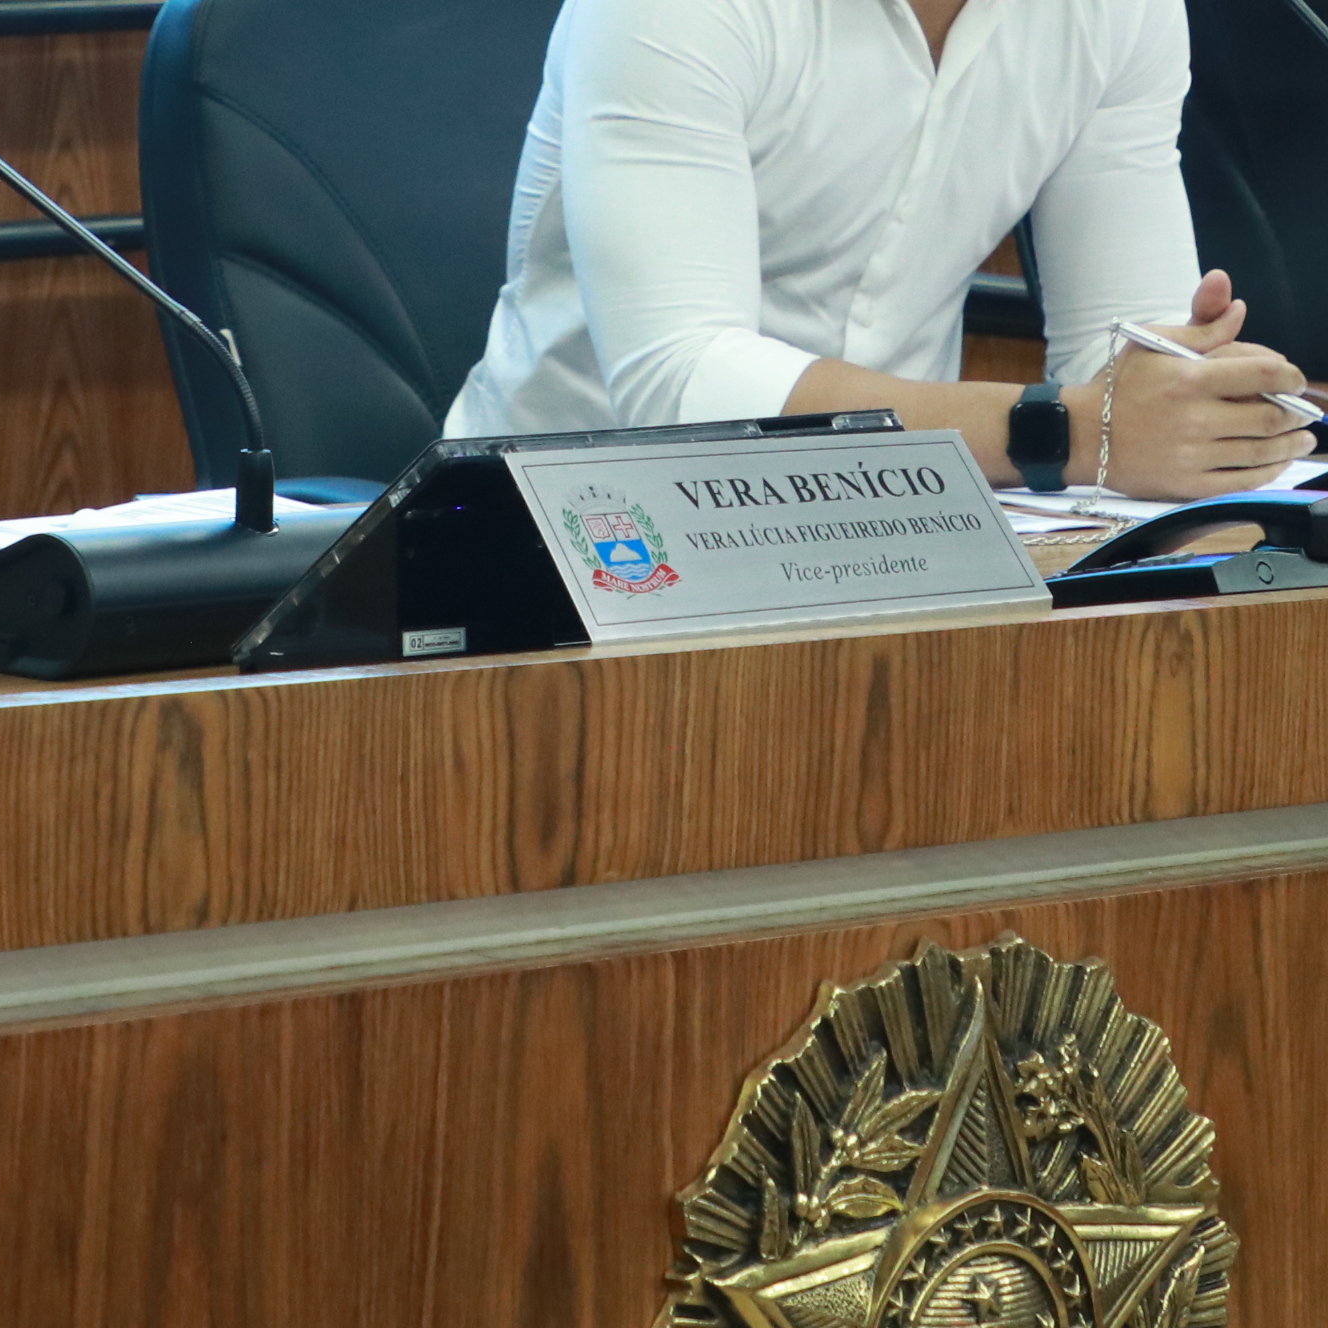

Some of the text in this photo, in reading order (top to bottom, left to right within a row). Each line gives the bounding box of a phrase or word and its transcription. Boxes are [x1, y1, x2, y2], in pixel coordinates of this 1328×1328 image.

[673, 462, 946, 511] VERA BENÍCIO
[684, 510, 982, 551] VERA LÚCIA FIGUEIREDO BENÍCIO
[601, 572, 630, 591] MARE
[780, 553, 929, 585] Vice-presidente
[411, 638, 422, 649] 02
